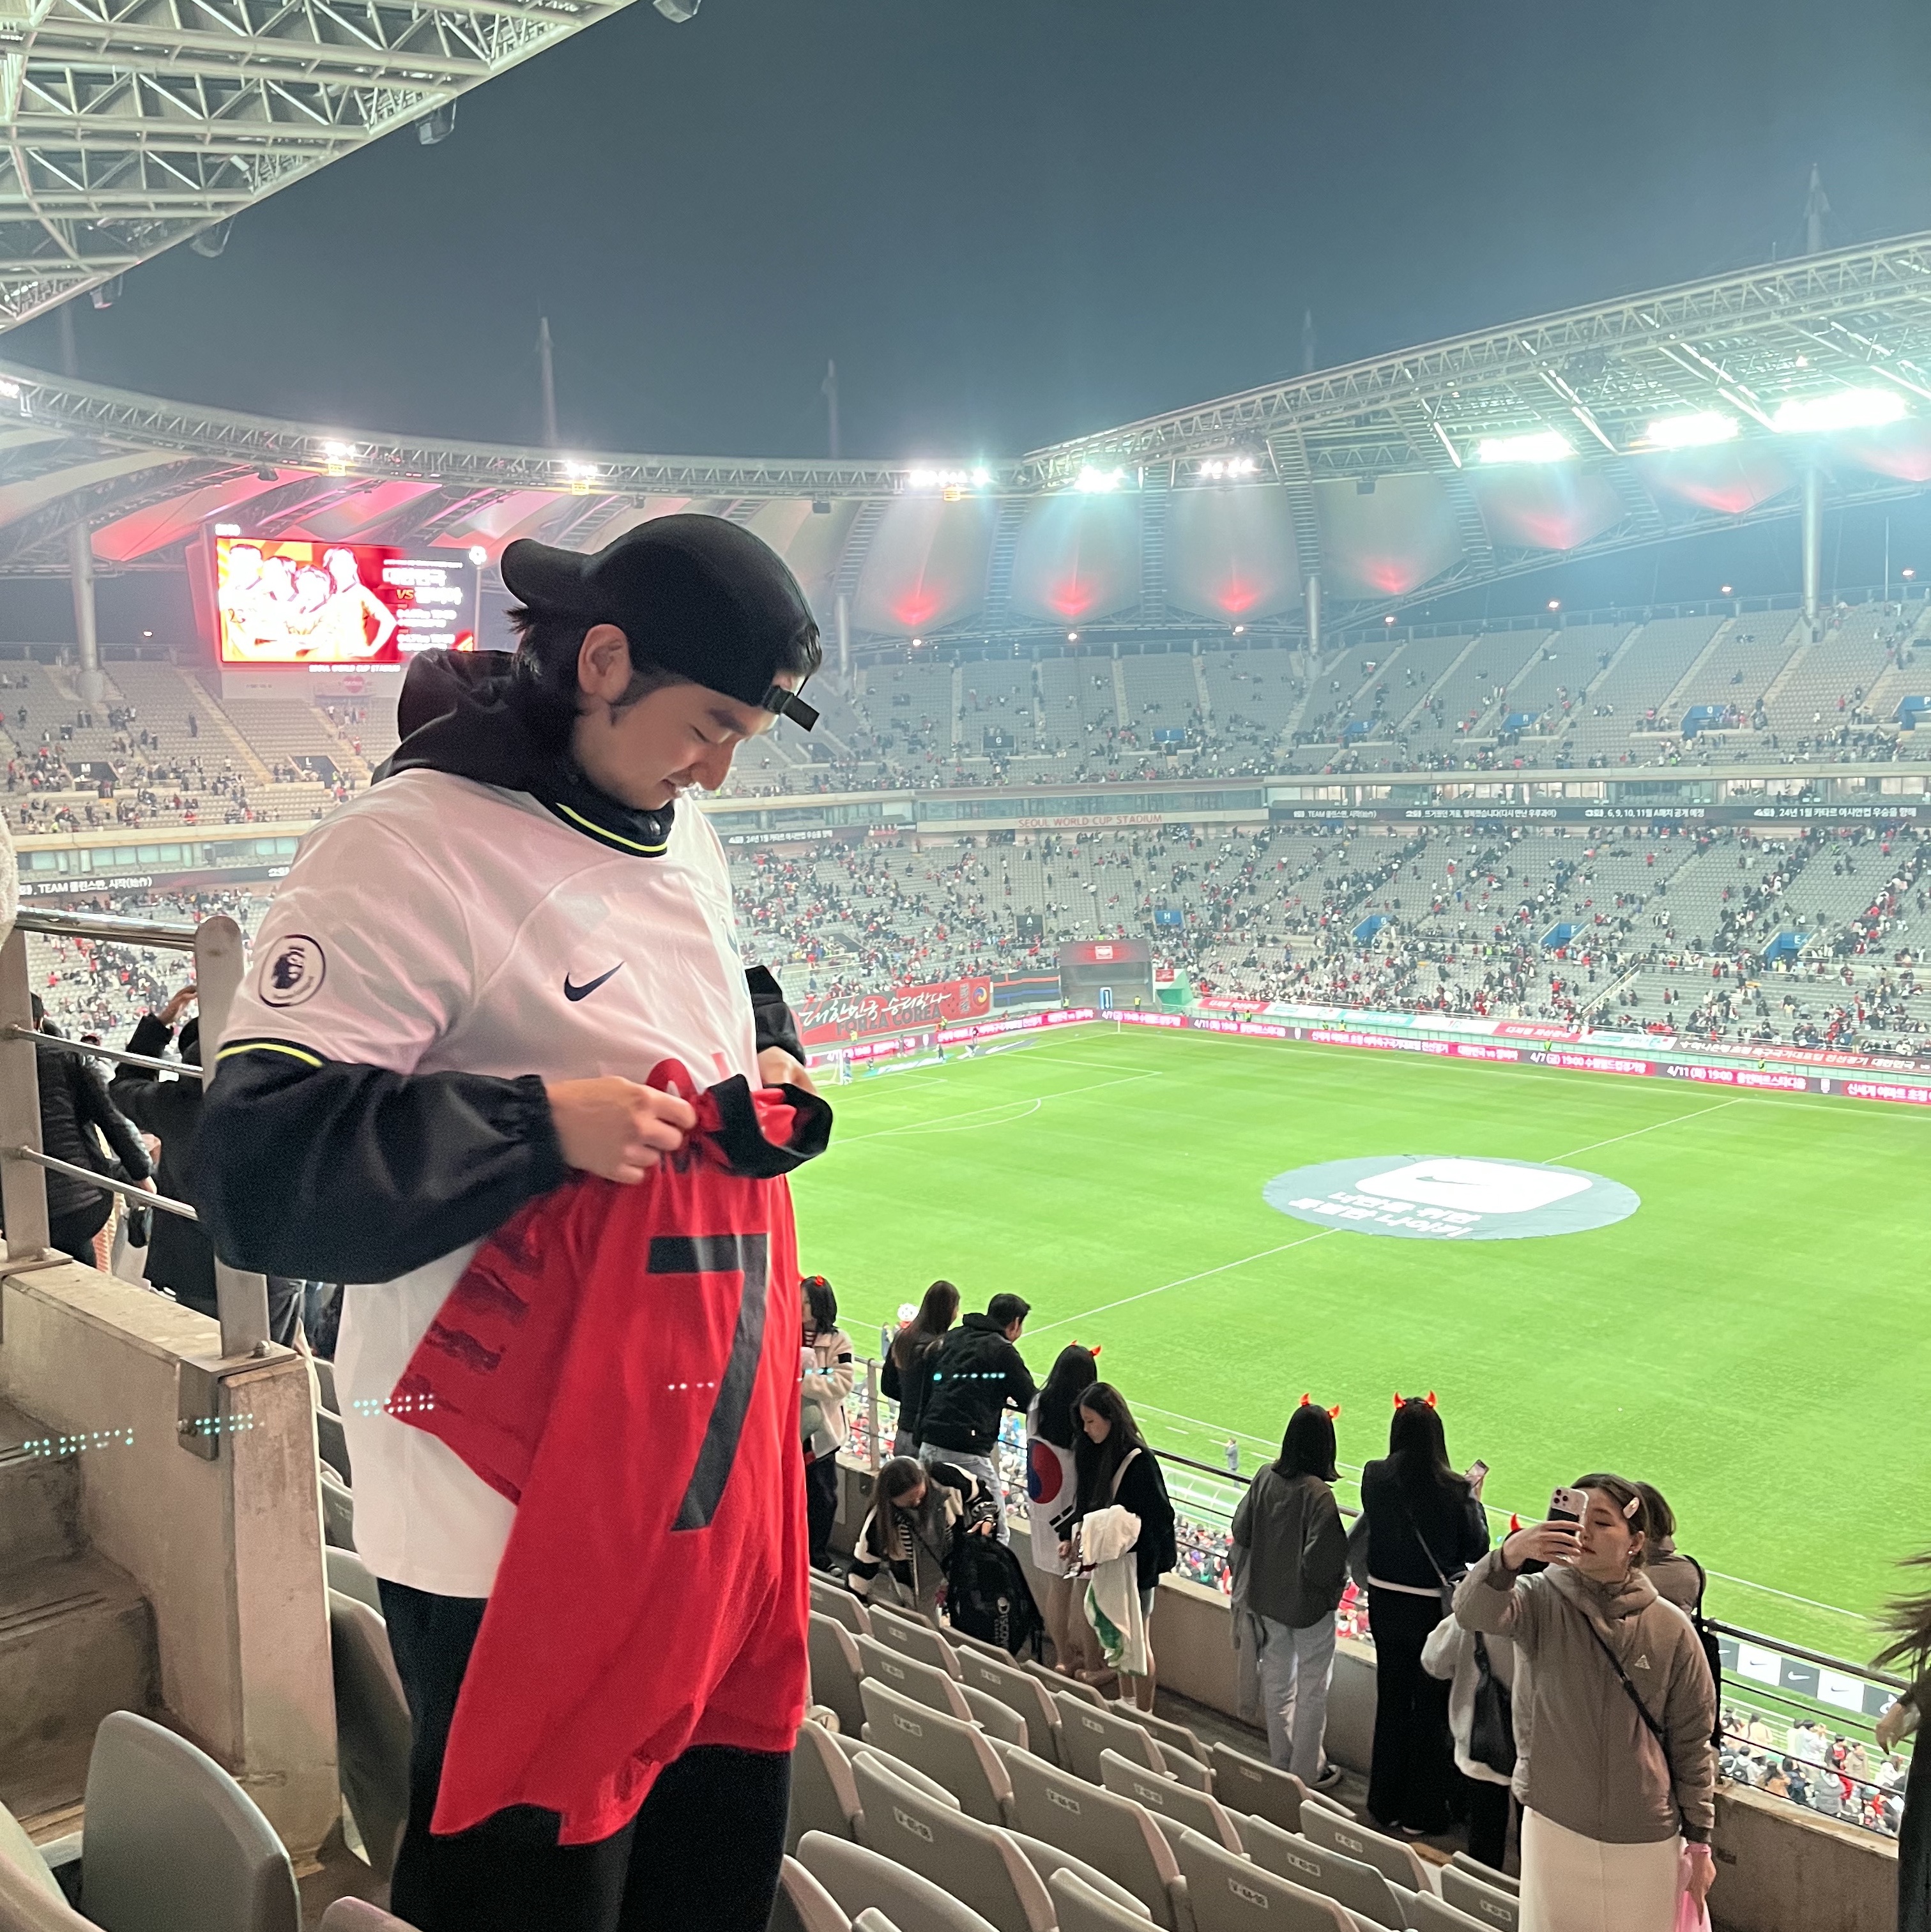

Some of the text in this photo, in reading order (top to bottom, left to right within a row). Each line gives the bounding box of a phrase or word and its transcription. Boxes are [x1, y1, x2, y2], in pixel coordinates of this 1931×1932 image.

[396, 589, 415, 600] VS
[1813, 808, 1837, 818] 카타르
[1018, 814, 1163, 828] SEOUL WORLD CUP STADIUM
[37, 883, 69, 894] TEAM
[798, 998, 878, 1026] 대한민국
[882, 991, 952, 1015] 승리한다
[1194, 1019, 1209, 1029] 4/11
[1530, 1051, 1546, 1063] 4/7
[1562, 1055, 1584, 1066] 19:00
[1667, 1065, 1689, 1077] 4/11
[1707, 1070, 1733, 1081] 19:00
[645, 1232, 771, 1532] 7
